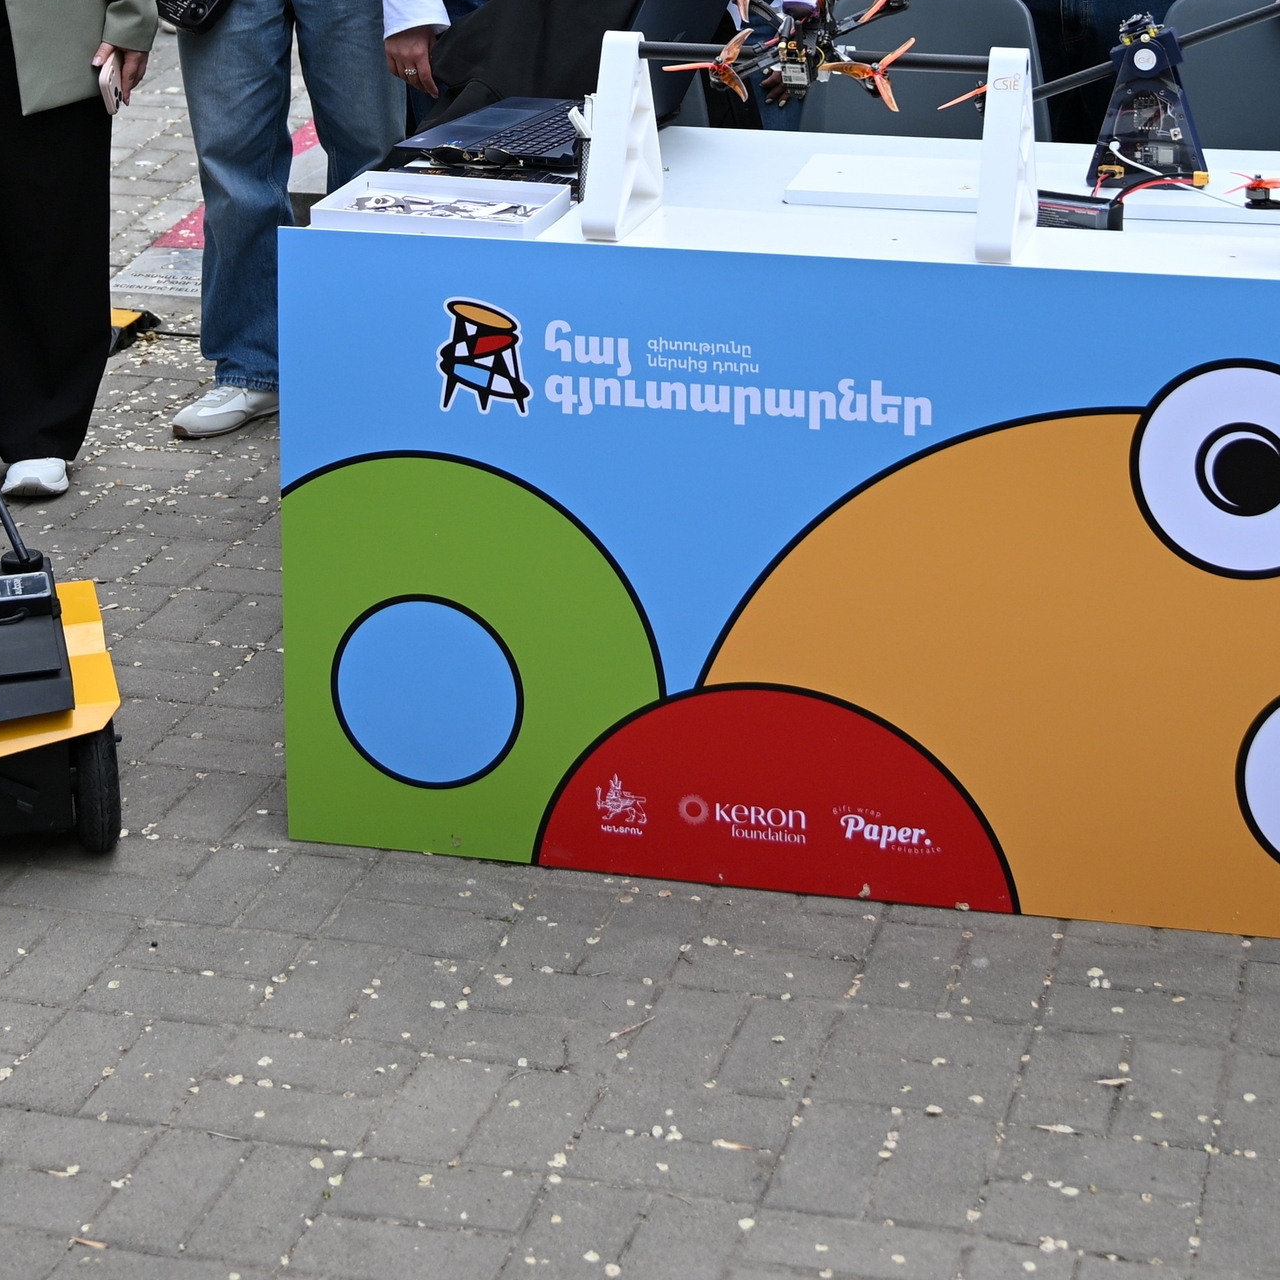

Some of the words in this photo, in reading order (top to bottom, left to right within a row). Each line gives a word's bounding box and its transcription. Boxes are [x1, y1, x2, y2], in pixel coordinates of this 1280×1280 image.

[647, 336, 752, 358] գիտությունը
[646, 353, 708, 373] ներսից
[713, 360, 760, 376] դուրս
[544, 371, 933, 436] գյուտարարներ
[856, 806, 881, 818] wrap
[601, 824, 643, 835] ԿԵՆՏՐՈՆ
[731, 823, 806, 844] foundation
[840, 813, 932, 849] Paper.
[890, 843, 942, 854] celebrate
